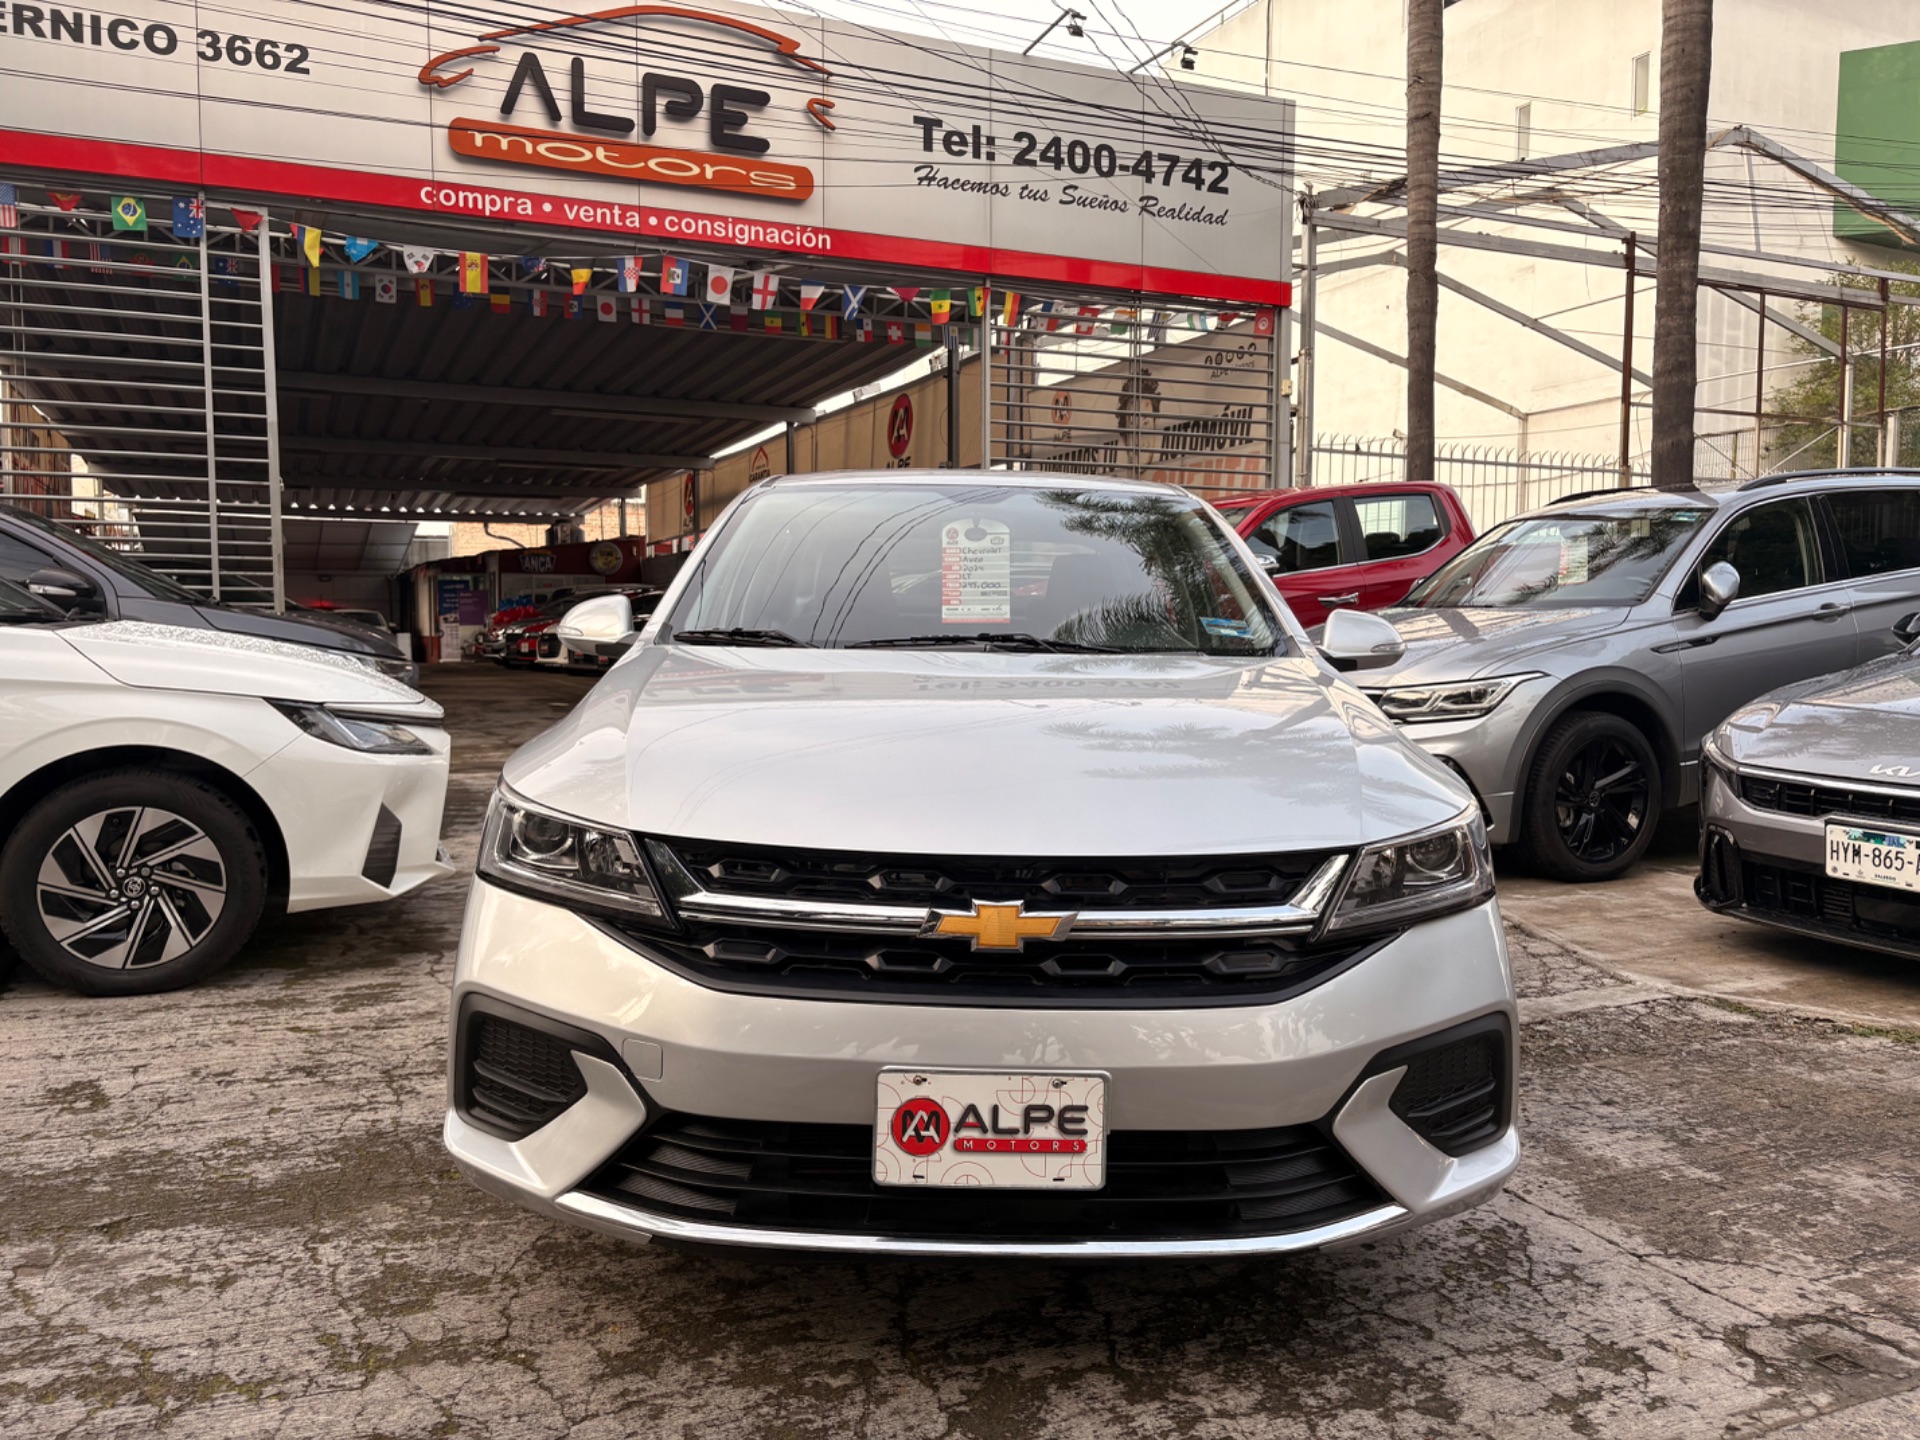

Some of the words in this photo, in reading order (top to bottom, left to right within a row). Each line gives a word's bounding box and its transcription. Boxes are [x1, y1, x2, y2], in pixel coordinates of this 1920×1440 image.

[0, 2, 178, 56] RNICO
[197, 29, 310, 75] 3662
[500, 51, 771, 153] ALPE
[467, 129, 798, 191] motors
[913, 115, 996, 162] Tel:
[1012, 131, 1229, 195] 2400-4742
[420, 185, 533, 216] compra
[564, 202, 641, 229] venta
[665, 213, 832, 251] consignación
[913, 165, 1011, 198] Hacemos
[1019, 183, 1050, 203] tus
[1059, 185, 1129, 213] Sueños
[1138, 195, 1229, 226] Realidad
[1829, 838, 1920, 876] HYM-865-
[954, 1103, 1089, 1135] ALPE
[962, 1139, 1080, 1151] MOTORS
